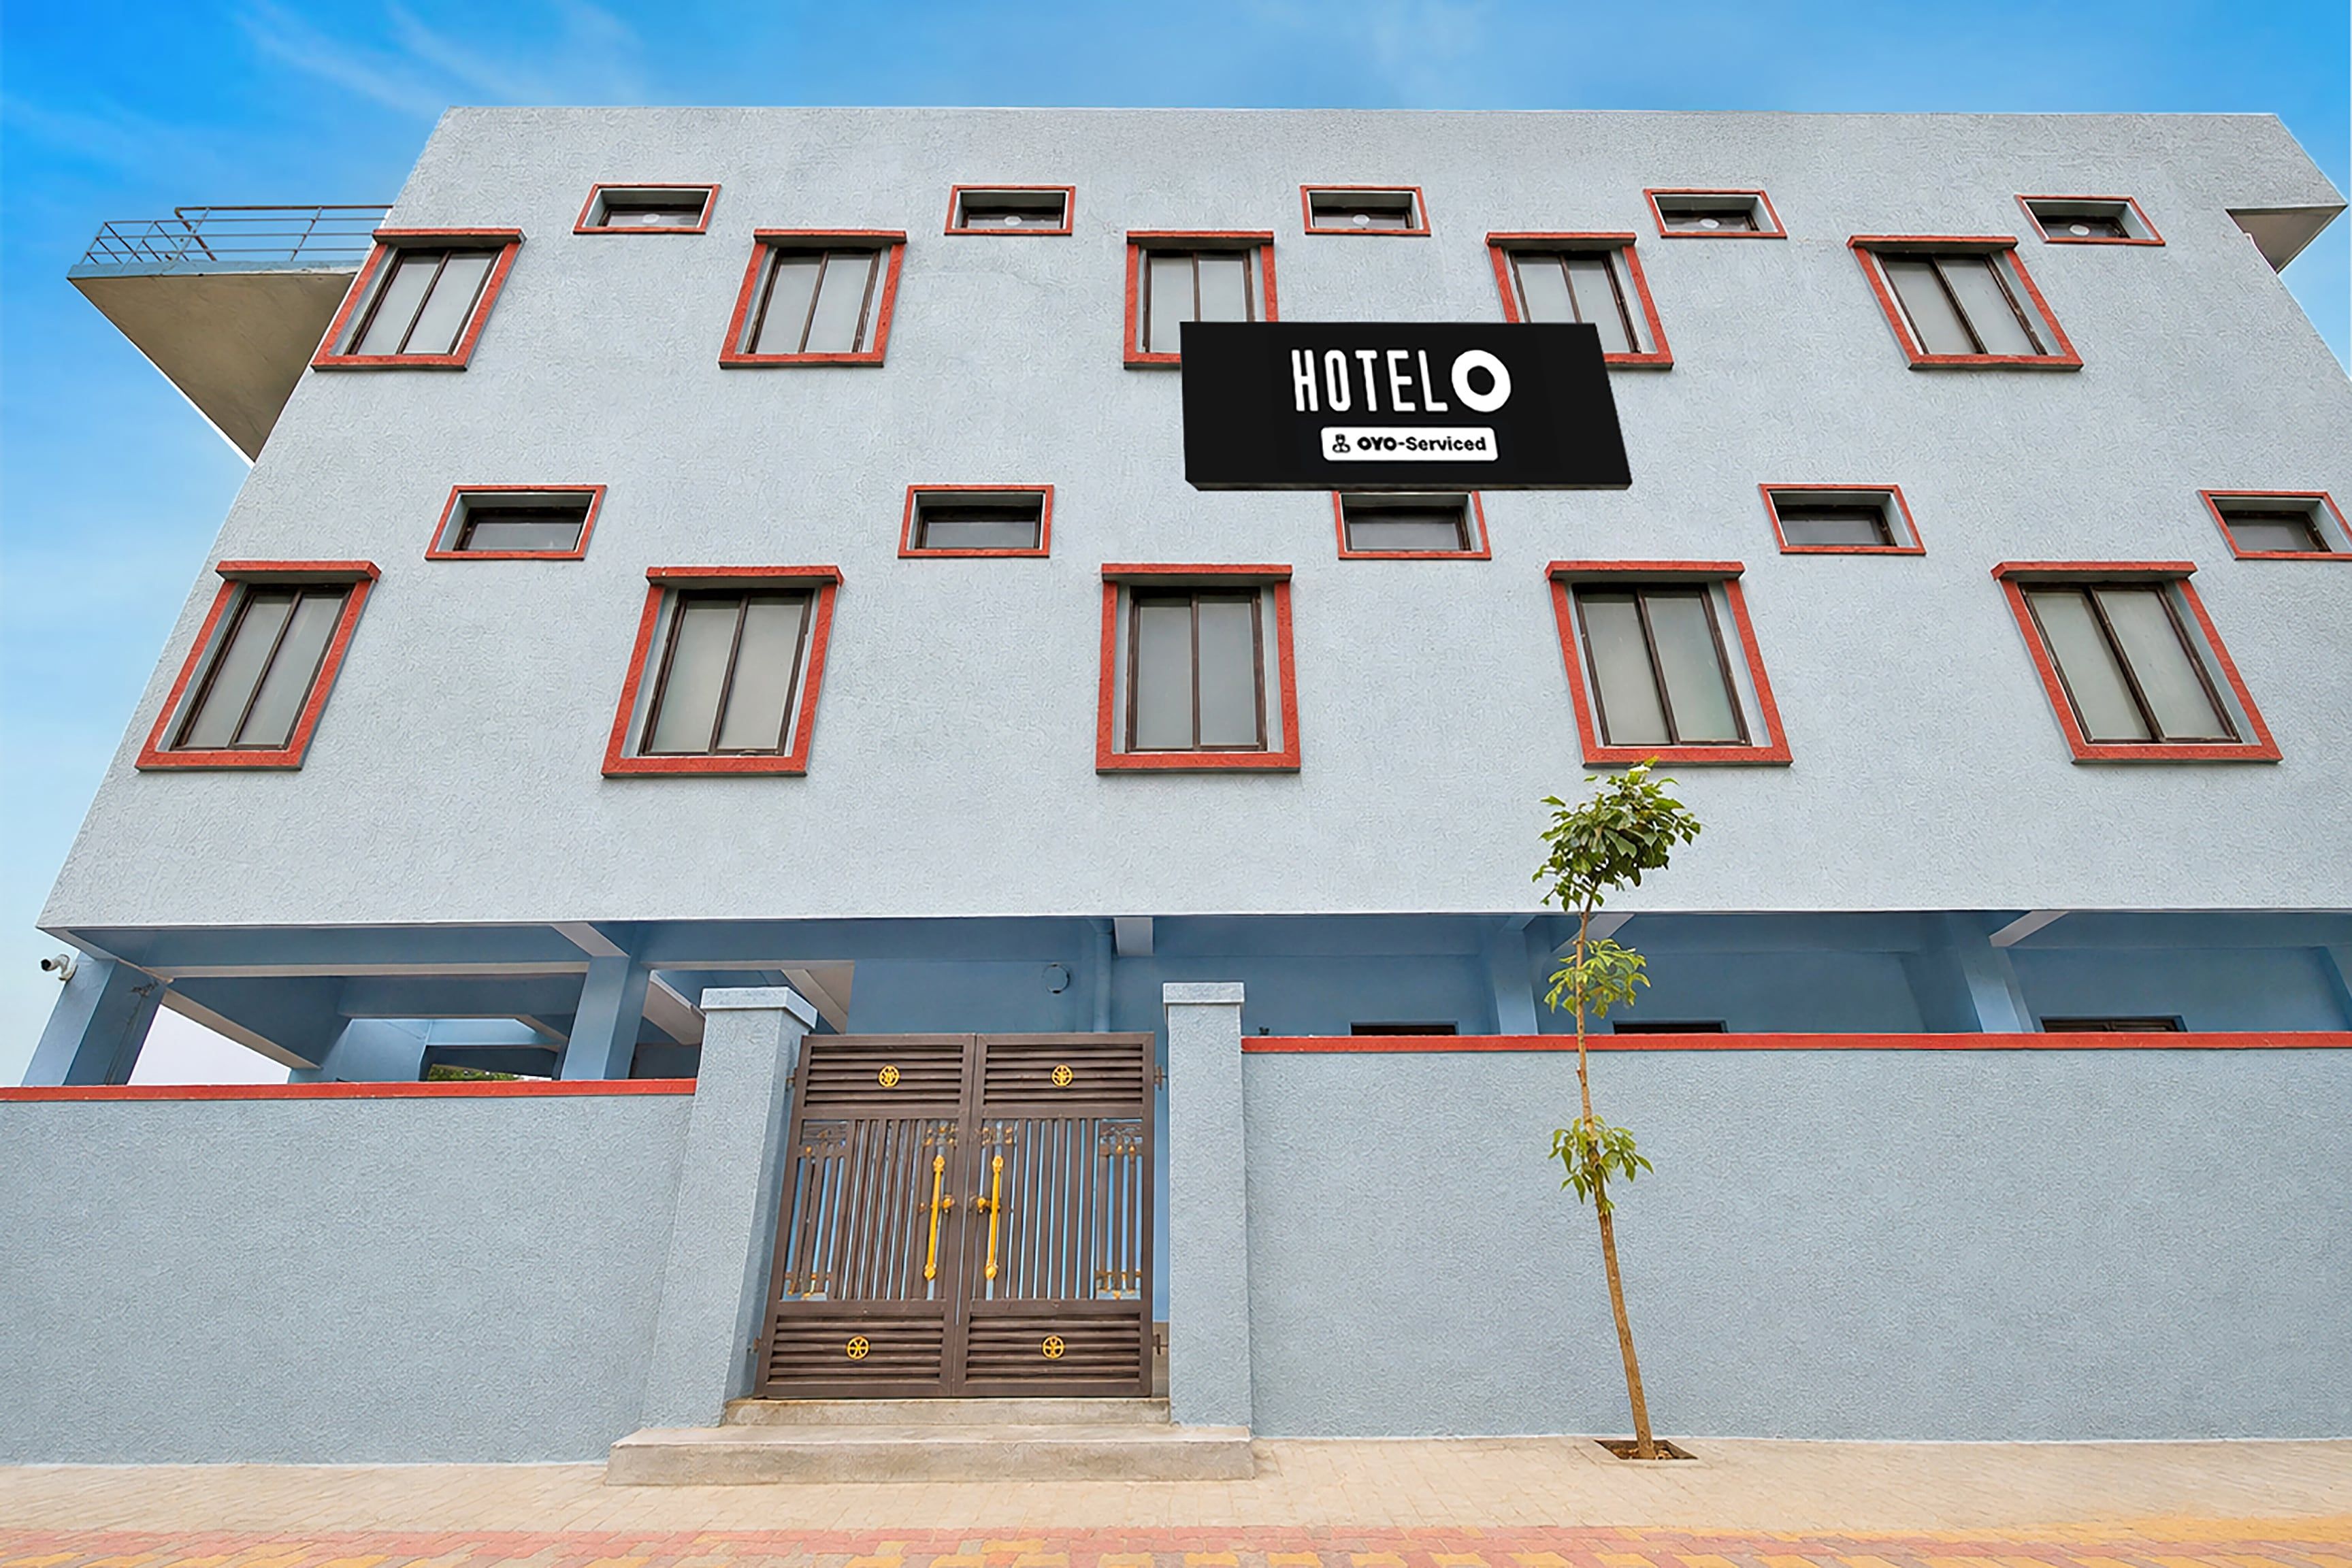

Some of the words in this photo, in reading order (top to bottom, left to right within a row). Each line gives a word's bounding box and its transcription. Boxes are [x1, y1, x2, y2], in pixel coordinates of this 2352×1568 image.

[1292, 349, 1448, 412] HOTEL
[1451, 349, 1512, 412] O
[1356, 436, 1486, 451] OYO-Serviced
